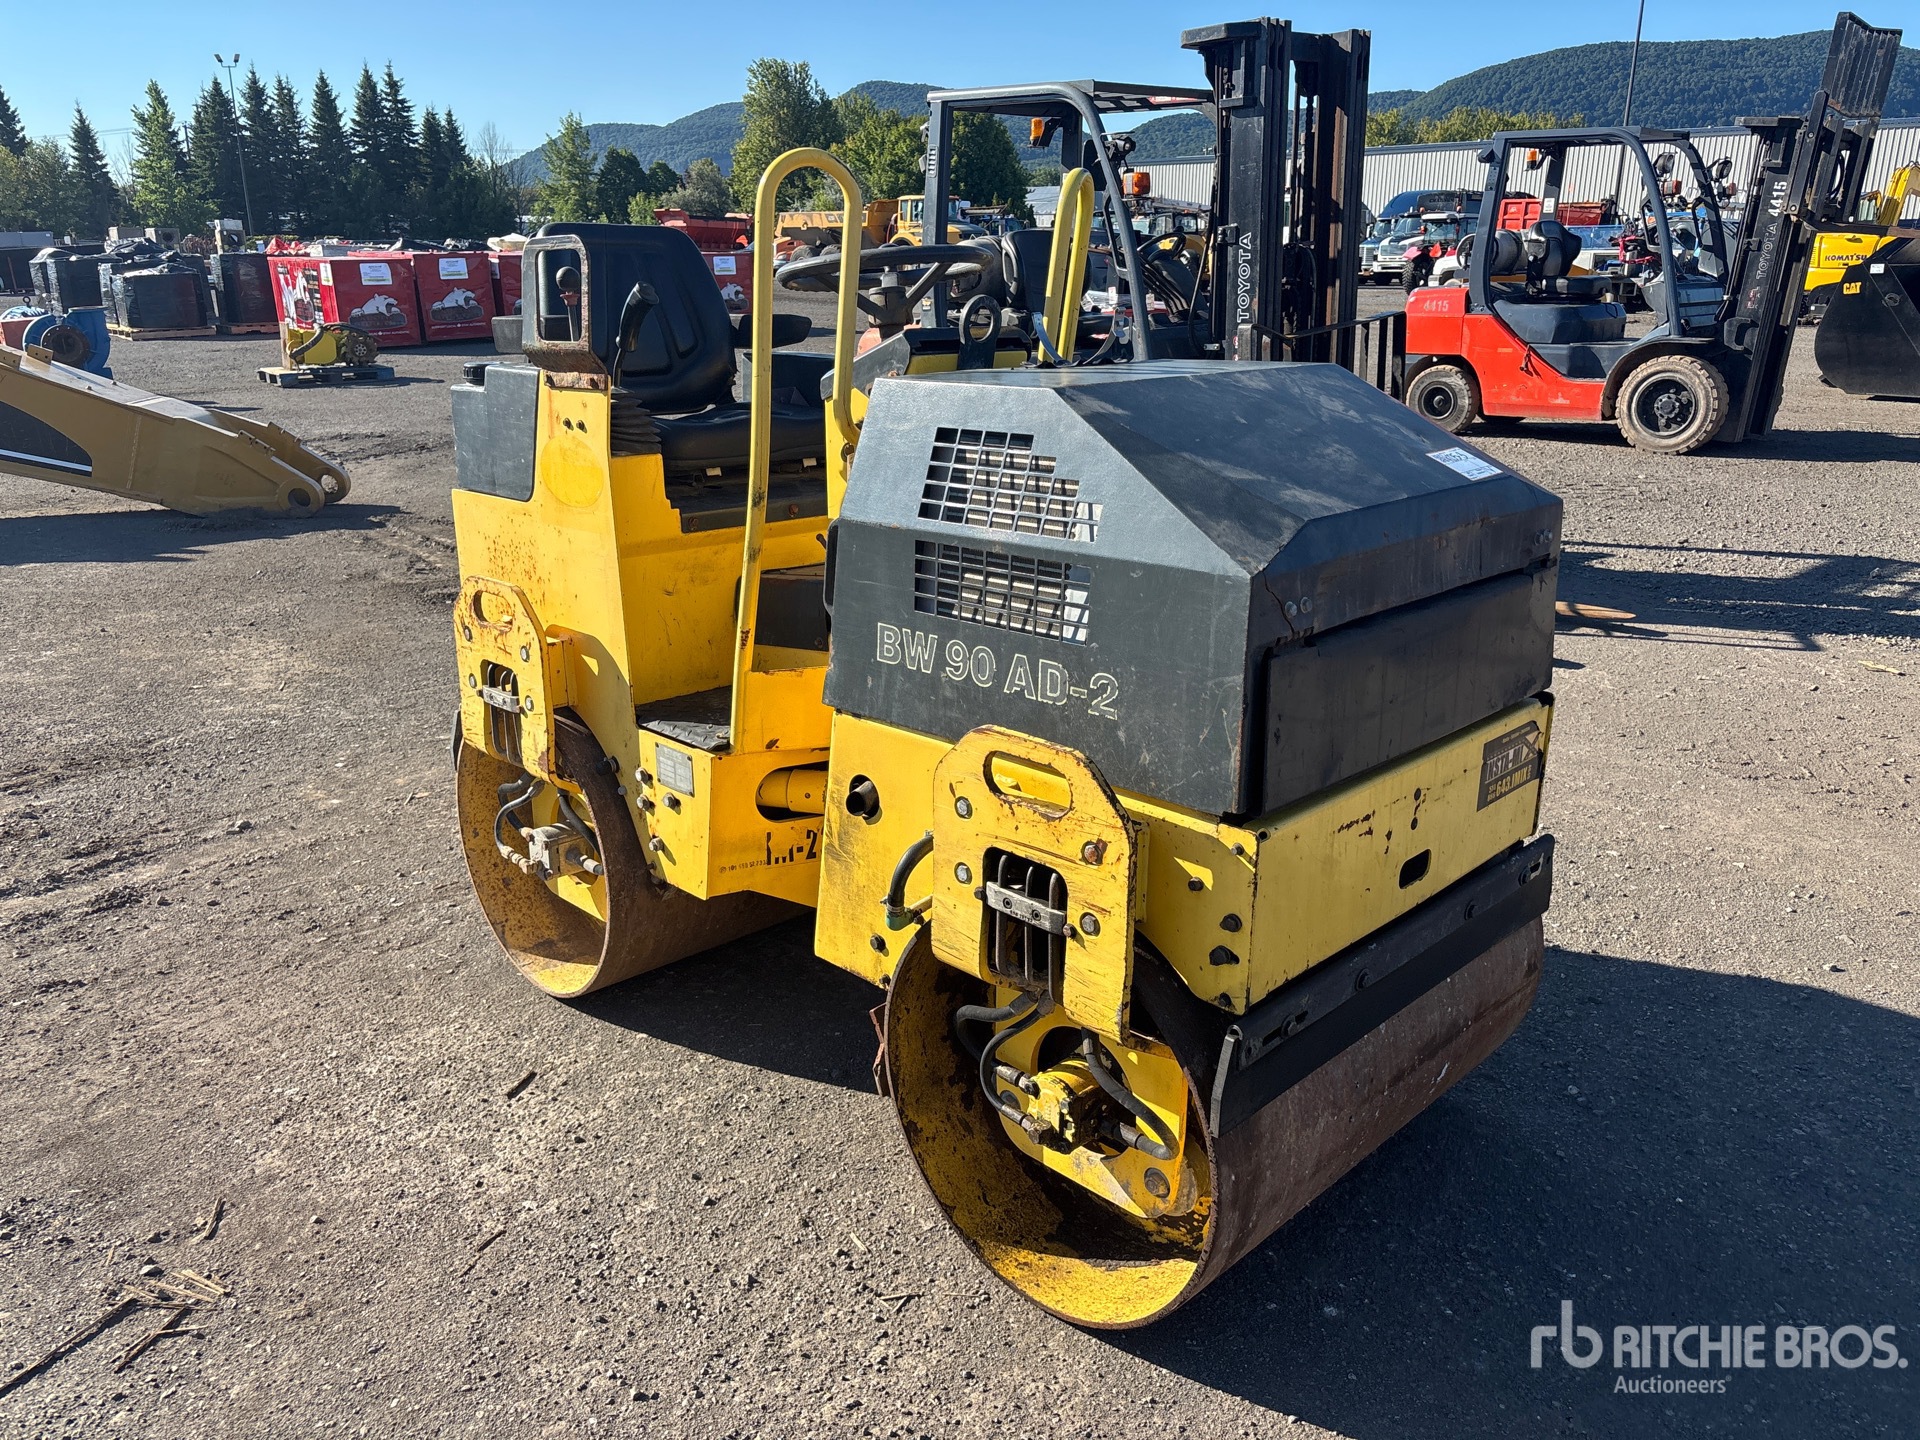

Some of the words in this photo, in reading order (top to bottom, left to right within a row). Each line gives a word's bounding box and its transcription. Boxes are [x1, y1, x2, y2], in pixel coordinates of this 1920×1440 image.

[1768, 181, 1788, 217] 4415
[1756, 223, 1778, 280] TOYOTA
[1825, 253, 1868, 262] KOMATSU
[1237, 232, 1252, 323] TOYOTA
[1843, 282, 1862, 295] CAT
[1423, 300, 1449, 312] 4415
[876, 622, 938, 674] BW
[945, 640, 997, 688] 90
[1003, 653, 1119, 721] AD-2
